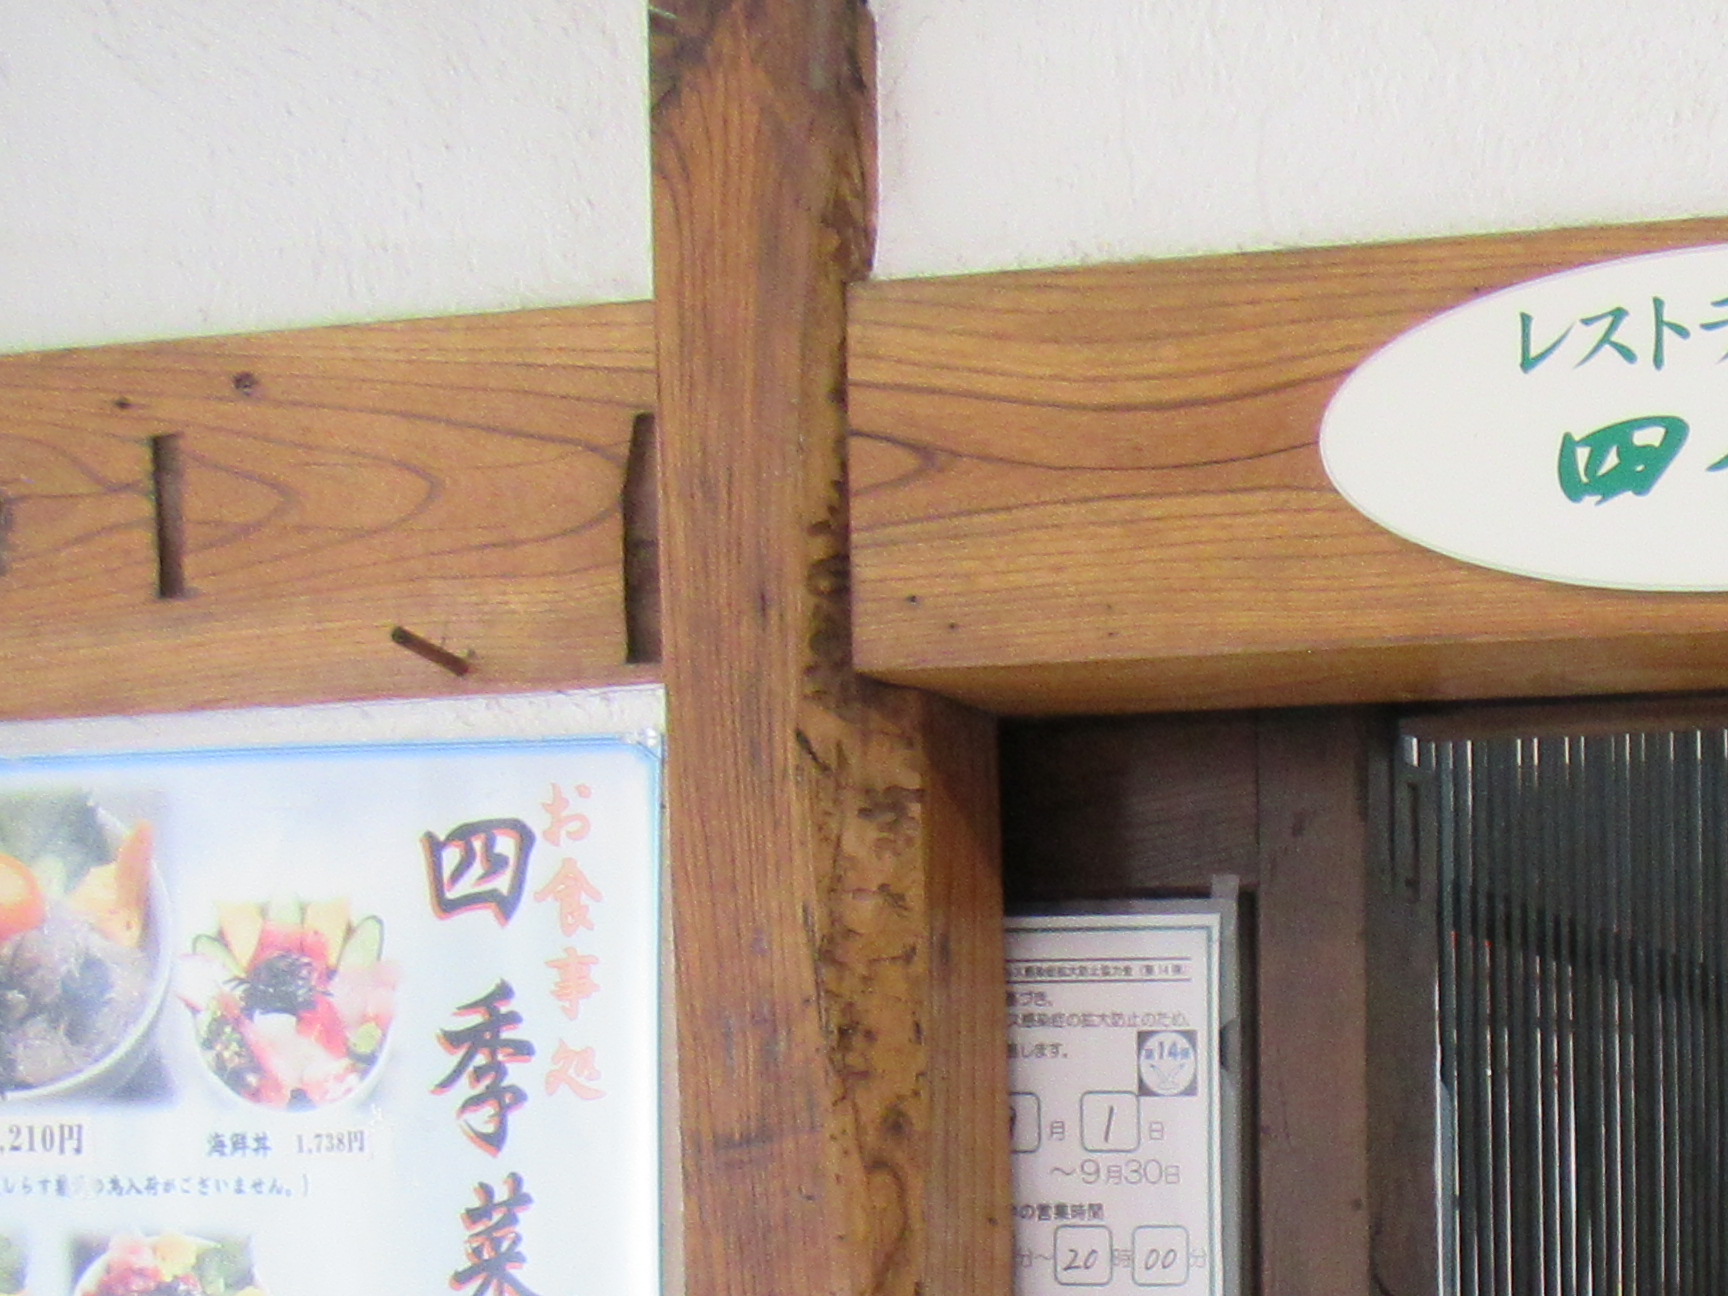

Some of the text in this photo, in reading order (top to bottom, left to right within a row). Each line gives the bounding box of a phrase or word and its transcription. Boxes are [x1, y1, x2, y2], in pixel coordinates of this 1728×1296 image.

[533, 781, 607, 1101] お食事処
[206, 1129, 368, 1158] 海鮮丼 1,738円
